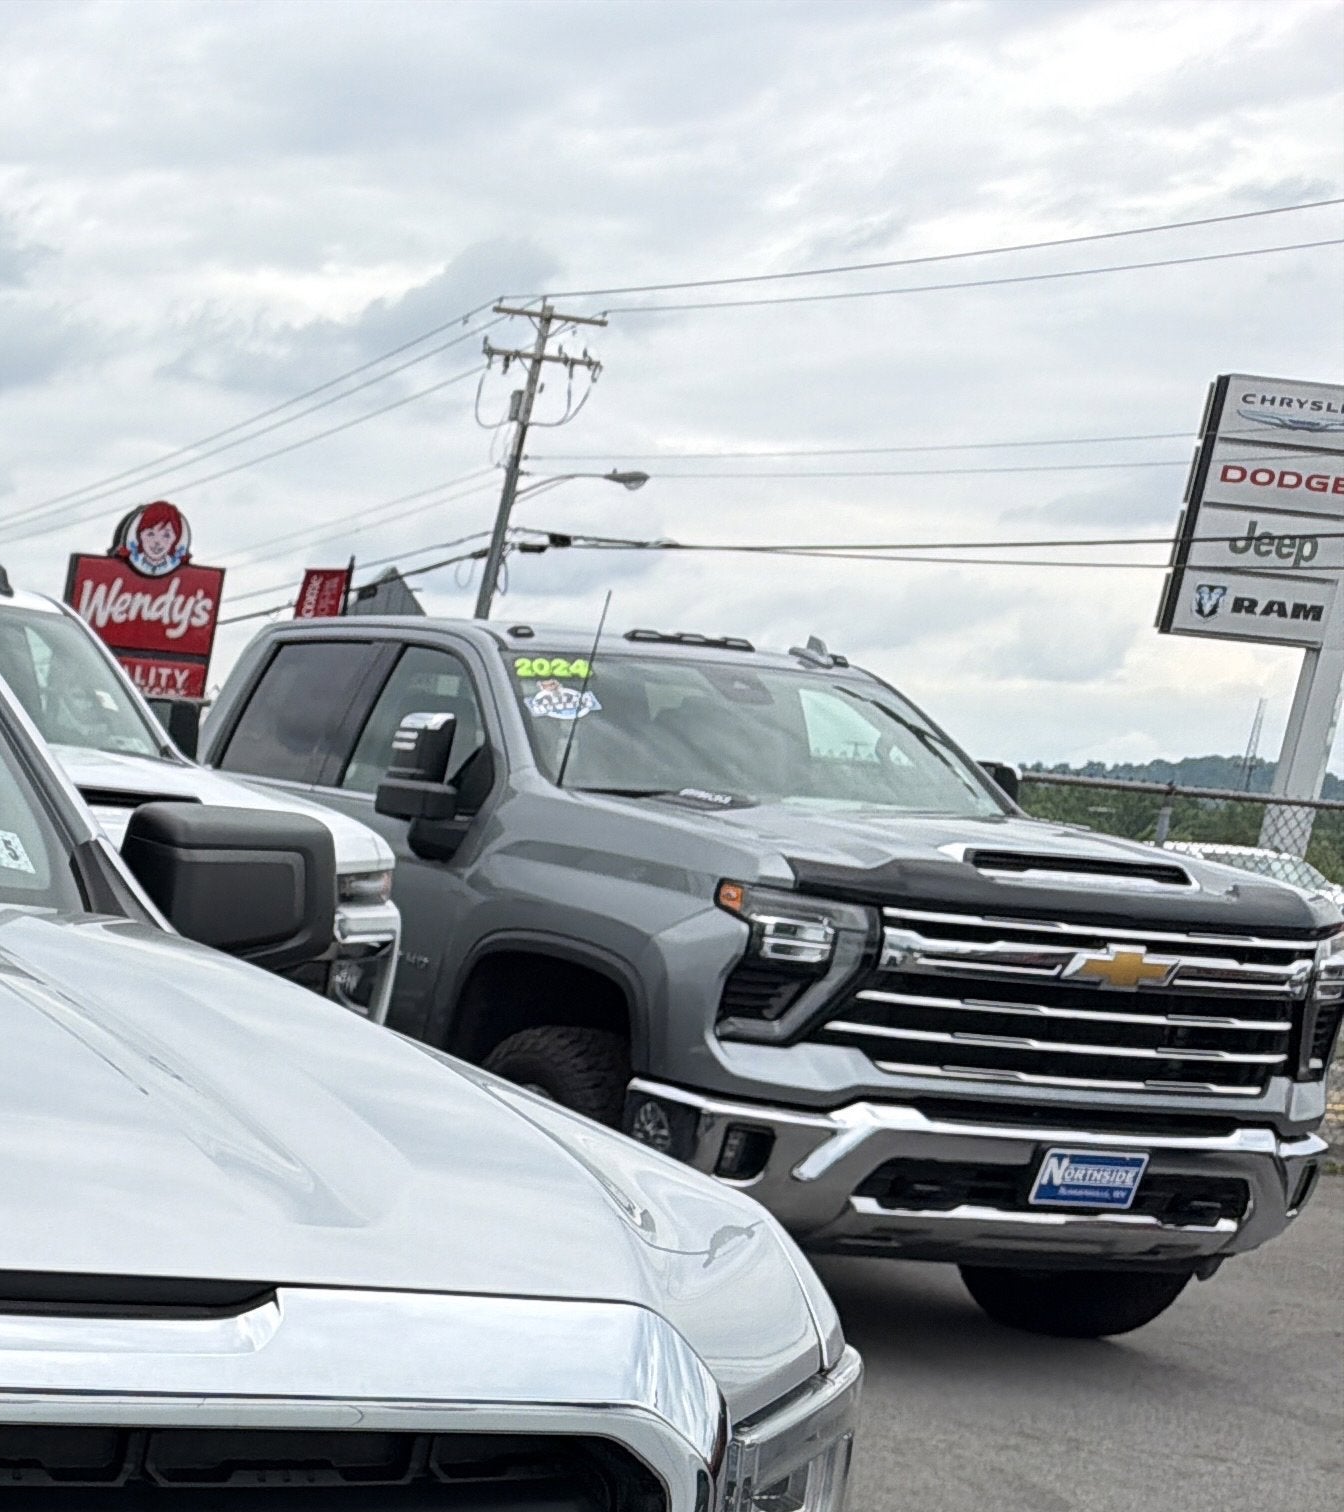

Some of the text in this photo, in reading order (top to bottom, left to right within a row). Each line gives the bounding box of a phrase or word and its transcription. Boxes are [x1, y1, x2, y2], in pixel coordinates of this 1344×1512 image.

[1229, 520, 1318, 568] Jeep
[79, 577, 213, 639] Wendy's
[1231, 596, 1325, 622] RAM
[125, 664, 190, 689] LITY
[514, 657, 593, 679] 2024
[2, 839, 20, 862] 5
